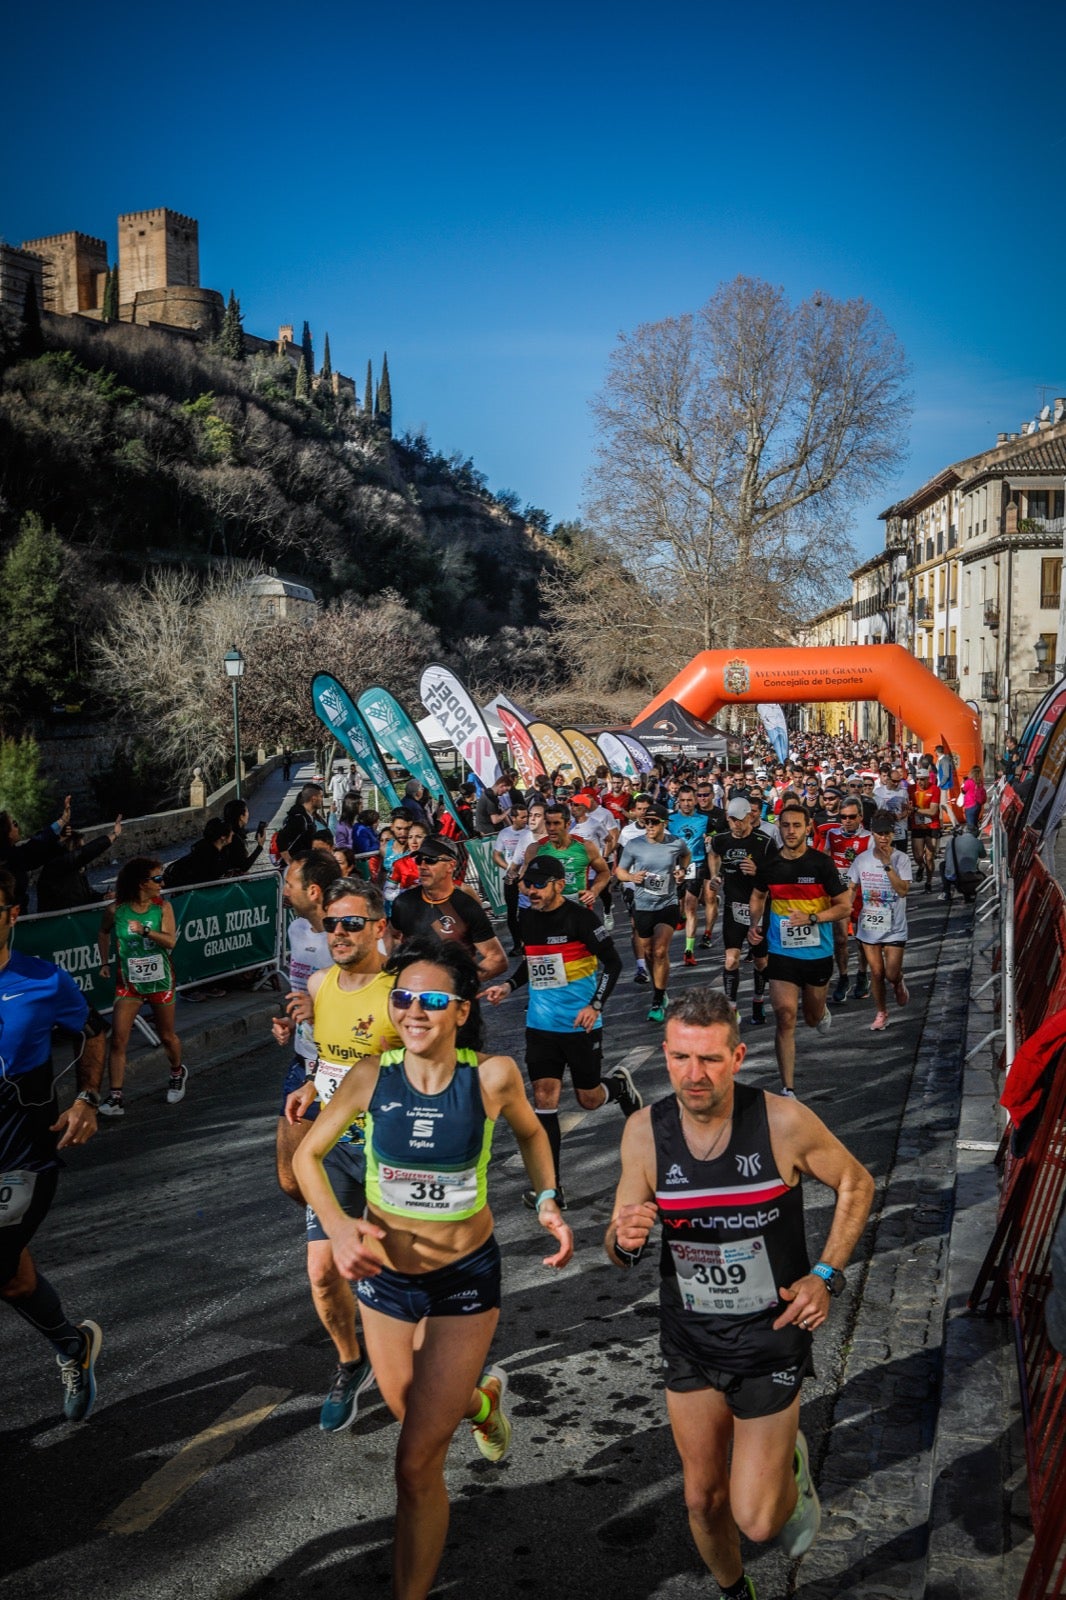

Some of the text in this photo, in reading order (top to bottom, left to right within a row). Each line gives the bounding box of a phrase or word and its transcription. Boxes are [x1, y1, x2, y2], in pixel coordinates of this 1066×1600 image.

[825, 677, 863, 686] Deportes
[184, 905, 270, 942] CAJA RURAL
[866, 915, 885, 923] 292
[787, 926, 811, 937] 510
[204, 932, 253, 957] GRANADA
[135, 962, 158, 973] 370
[532, 964, 555, 976] 505
[328, 1044, 373, 1059] Vigilsa
[409, 1140, 435, 1149] Vigilsa
[383, 1167, 434, 1180] 9 Carrera
[410, 1181, 446, 1200] 38
[676, 1244, 722, 1259] 9 Carrera
[692, 1263, 747, 1286] 309
